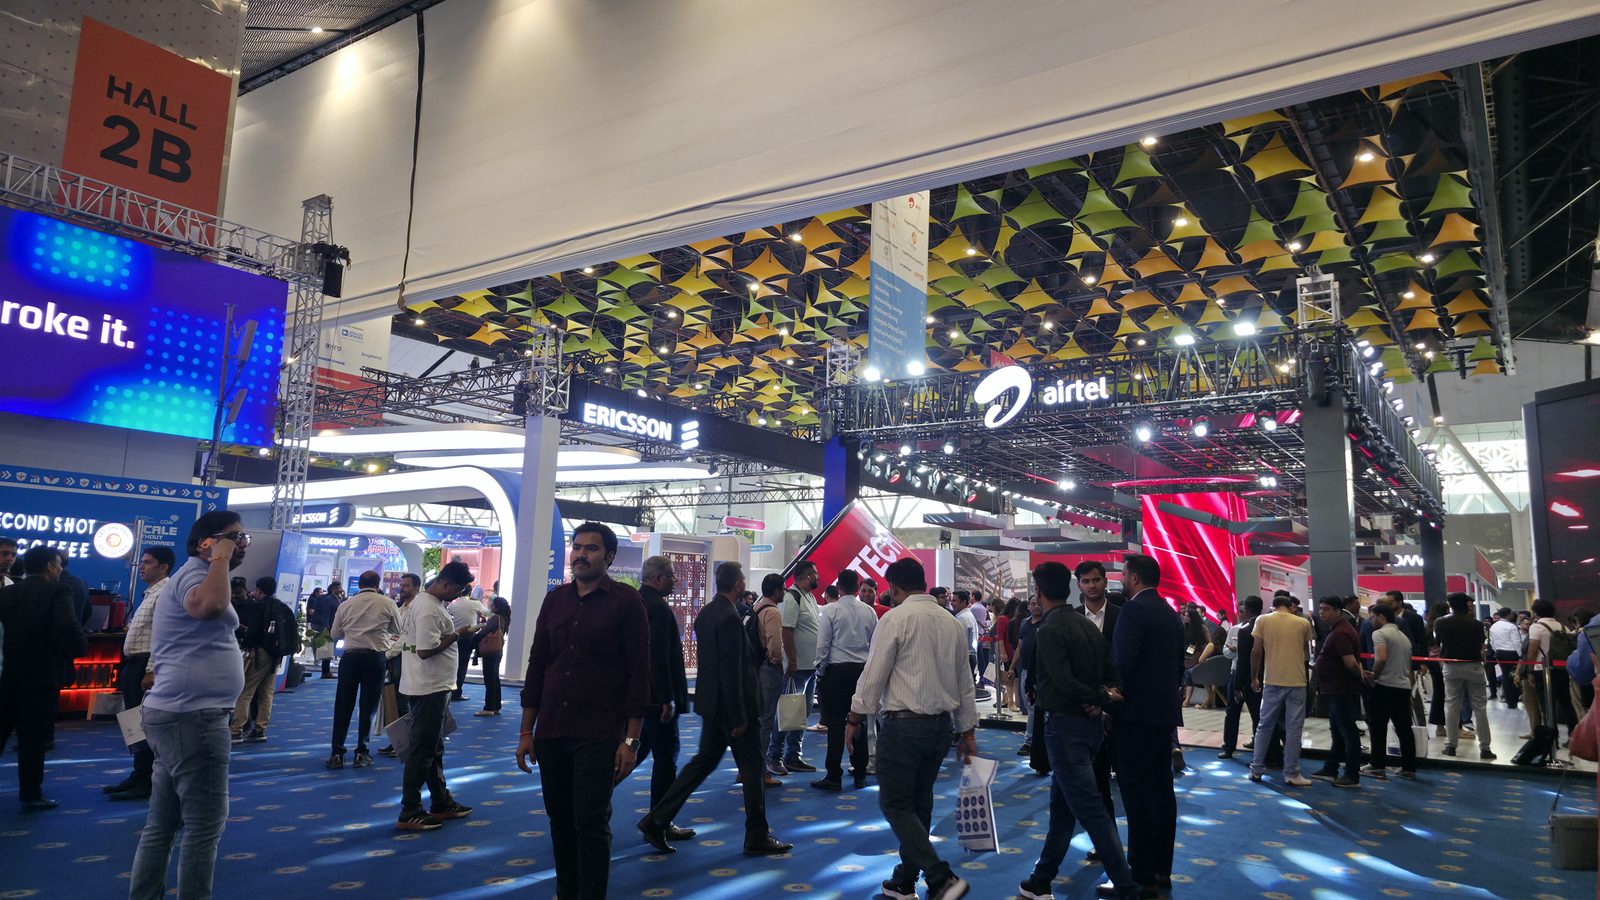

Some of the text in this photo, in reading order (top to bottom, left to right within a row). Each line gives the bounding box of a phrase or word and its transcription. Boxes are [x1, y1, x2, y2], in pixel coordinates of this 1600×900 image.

[106, 75, 198, 131] HALL
[100, 114, 192, 183] 2B
[0, 301, 135, 349] roke it.
[1043, 376, 1109, 405] airtel
[583, 402, 673, 441] ERICSSON
[0, 511, 97, 536] COND SHOT
[143, 525, 178, 536] CALE
[308, 536, 347, 547] RICSSON
